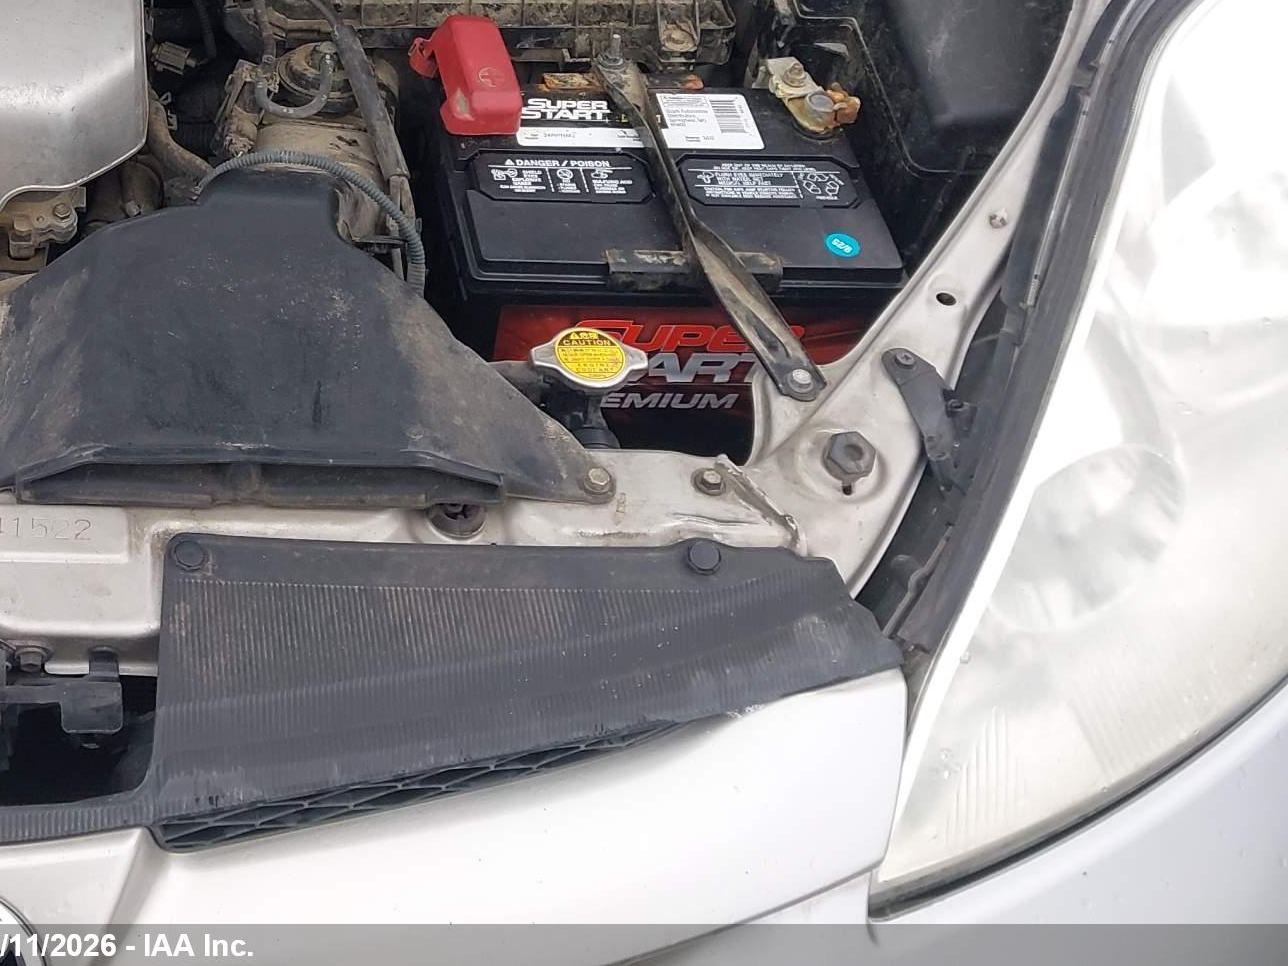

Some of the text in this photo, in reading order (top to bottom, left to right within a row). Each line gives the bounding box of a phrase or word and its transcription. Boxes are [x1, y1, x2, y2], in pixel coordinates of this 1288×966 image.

[527, 98, 609, 110] SUPER
[520, 108, 612, 120] START
[515, 159, 560, 167] DANGER
[569, 160, 611, 168] POISON
[600, 393, 740, 409] EMIUM
